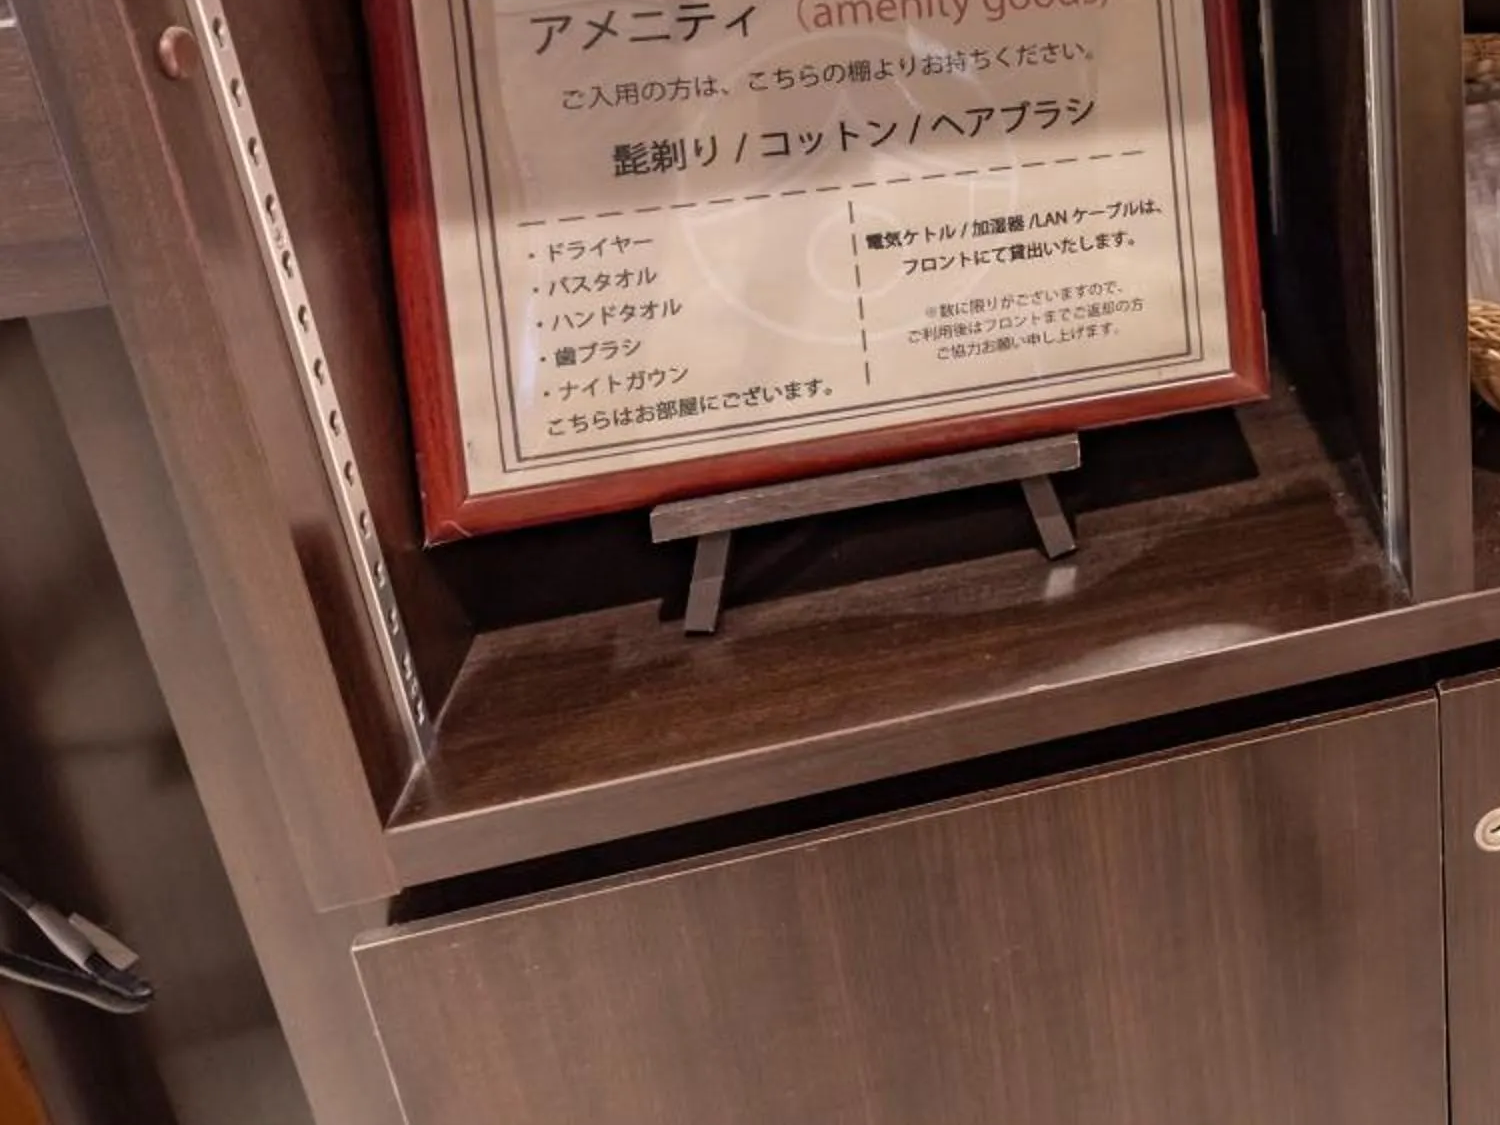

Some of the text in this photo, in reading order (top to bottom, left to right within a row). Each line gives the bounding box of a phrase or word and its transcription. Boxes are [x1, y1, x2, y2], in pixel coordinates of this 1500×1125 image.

[529, 2, 756, 55] アメニティ
[546, 377, 834, 436] こちらはお部屋にございます。
